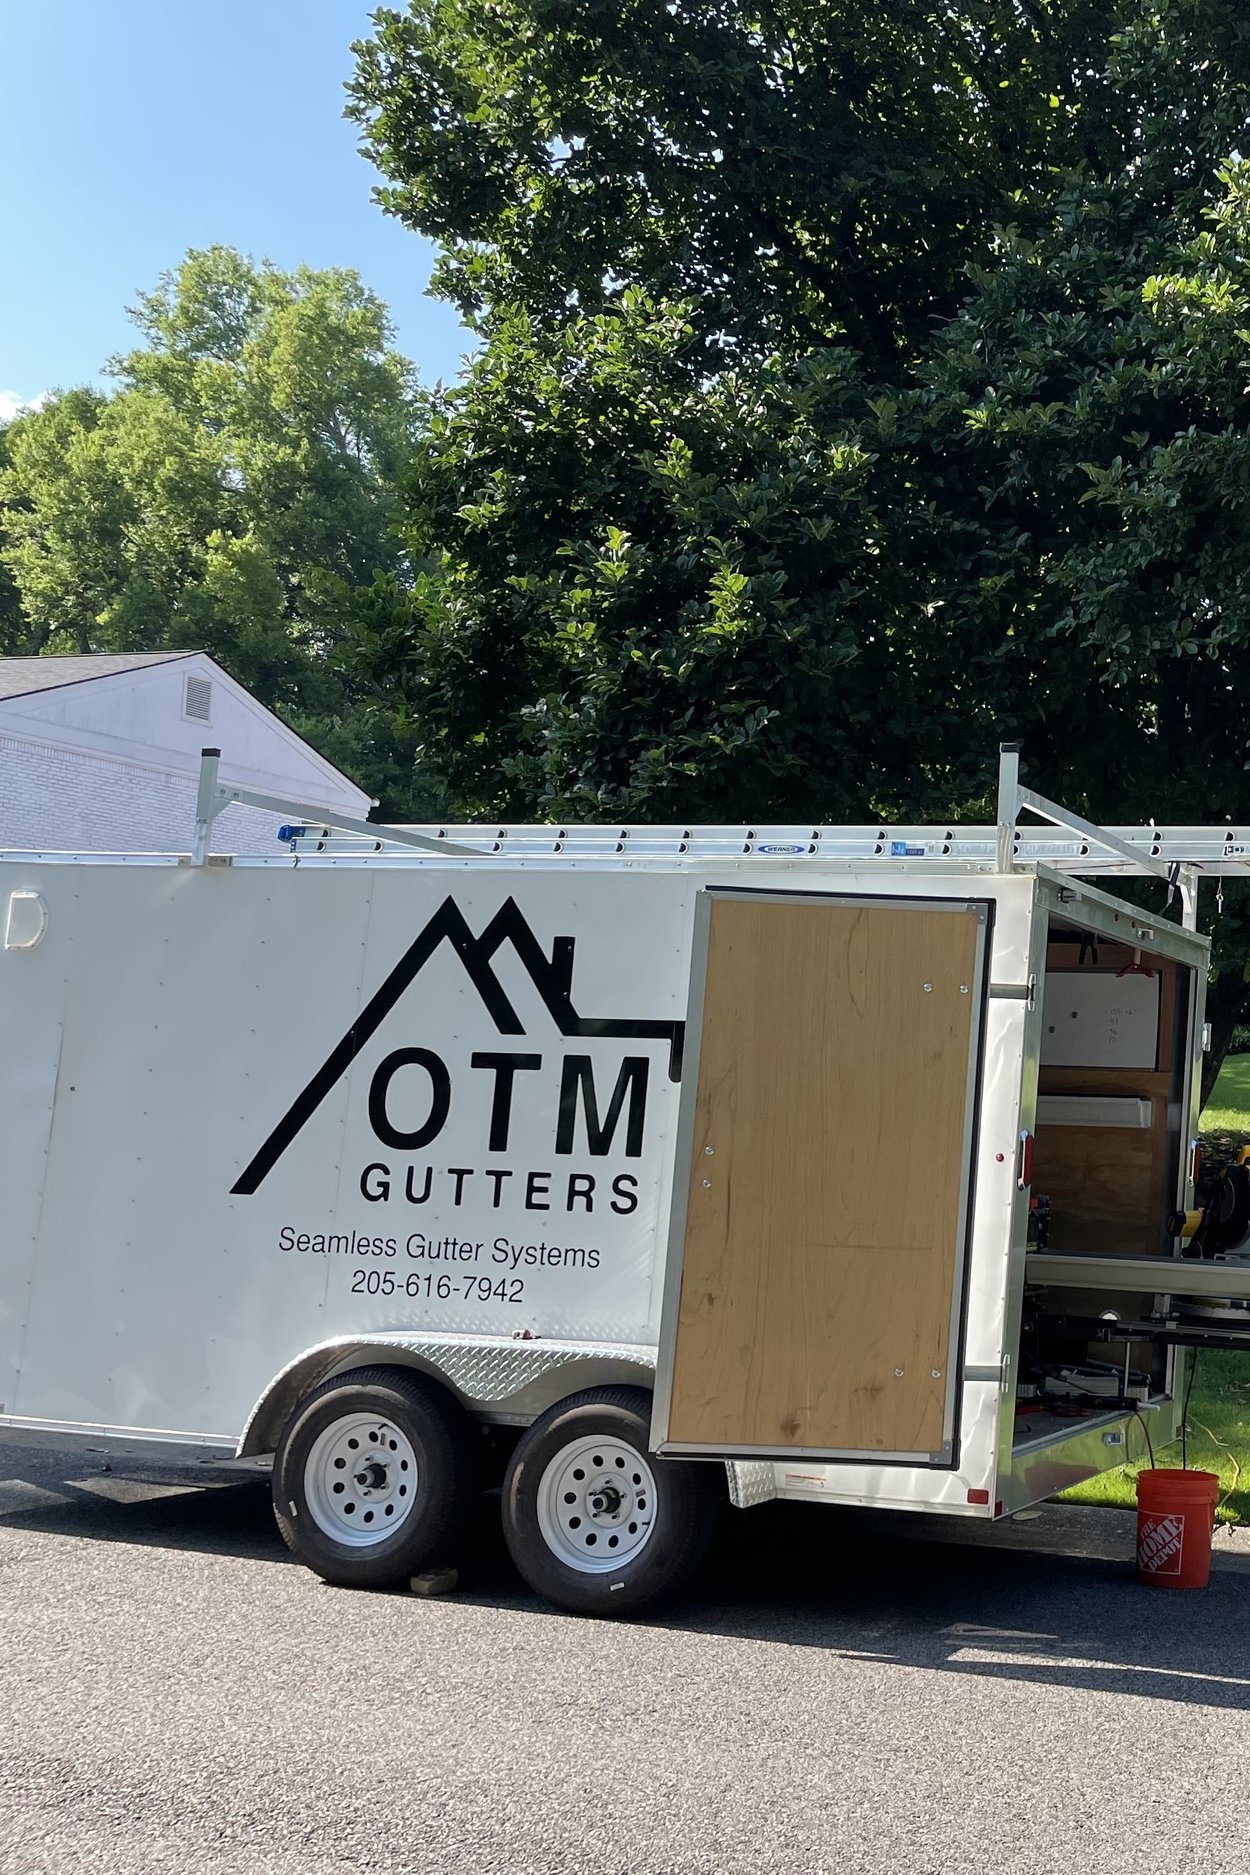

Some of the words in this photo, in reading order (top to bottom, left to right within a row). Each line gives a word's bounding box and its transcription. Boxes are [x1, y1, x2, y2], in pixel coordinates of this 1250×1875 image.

[367, 1045, 651, 1159] OTM
[359, 1161, 639, 1216] GUTTERS
[278, 1226, 398, 1258] Seamless
[405, 1233, 484, 1263] Gutter
[490, 1237, 601, 1272] Systems
[350, 1269, 525, 1304] 205-616-7942
[1138, 1515, 1183, 1568] HOME
[1140, 1518, 1157, 1540] THE
[1147, 1537, 1182, 1571] DEPOT
